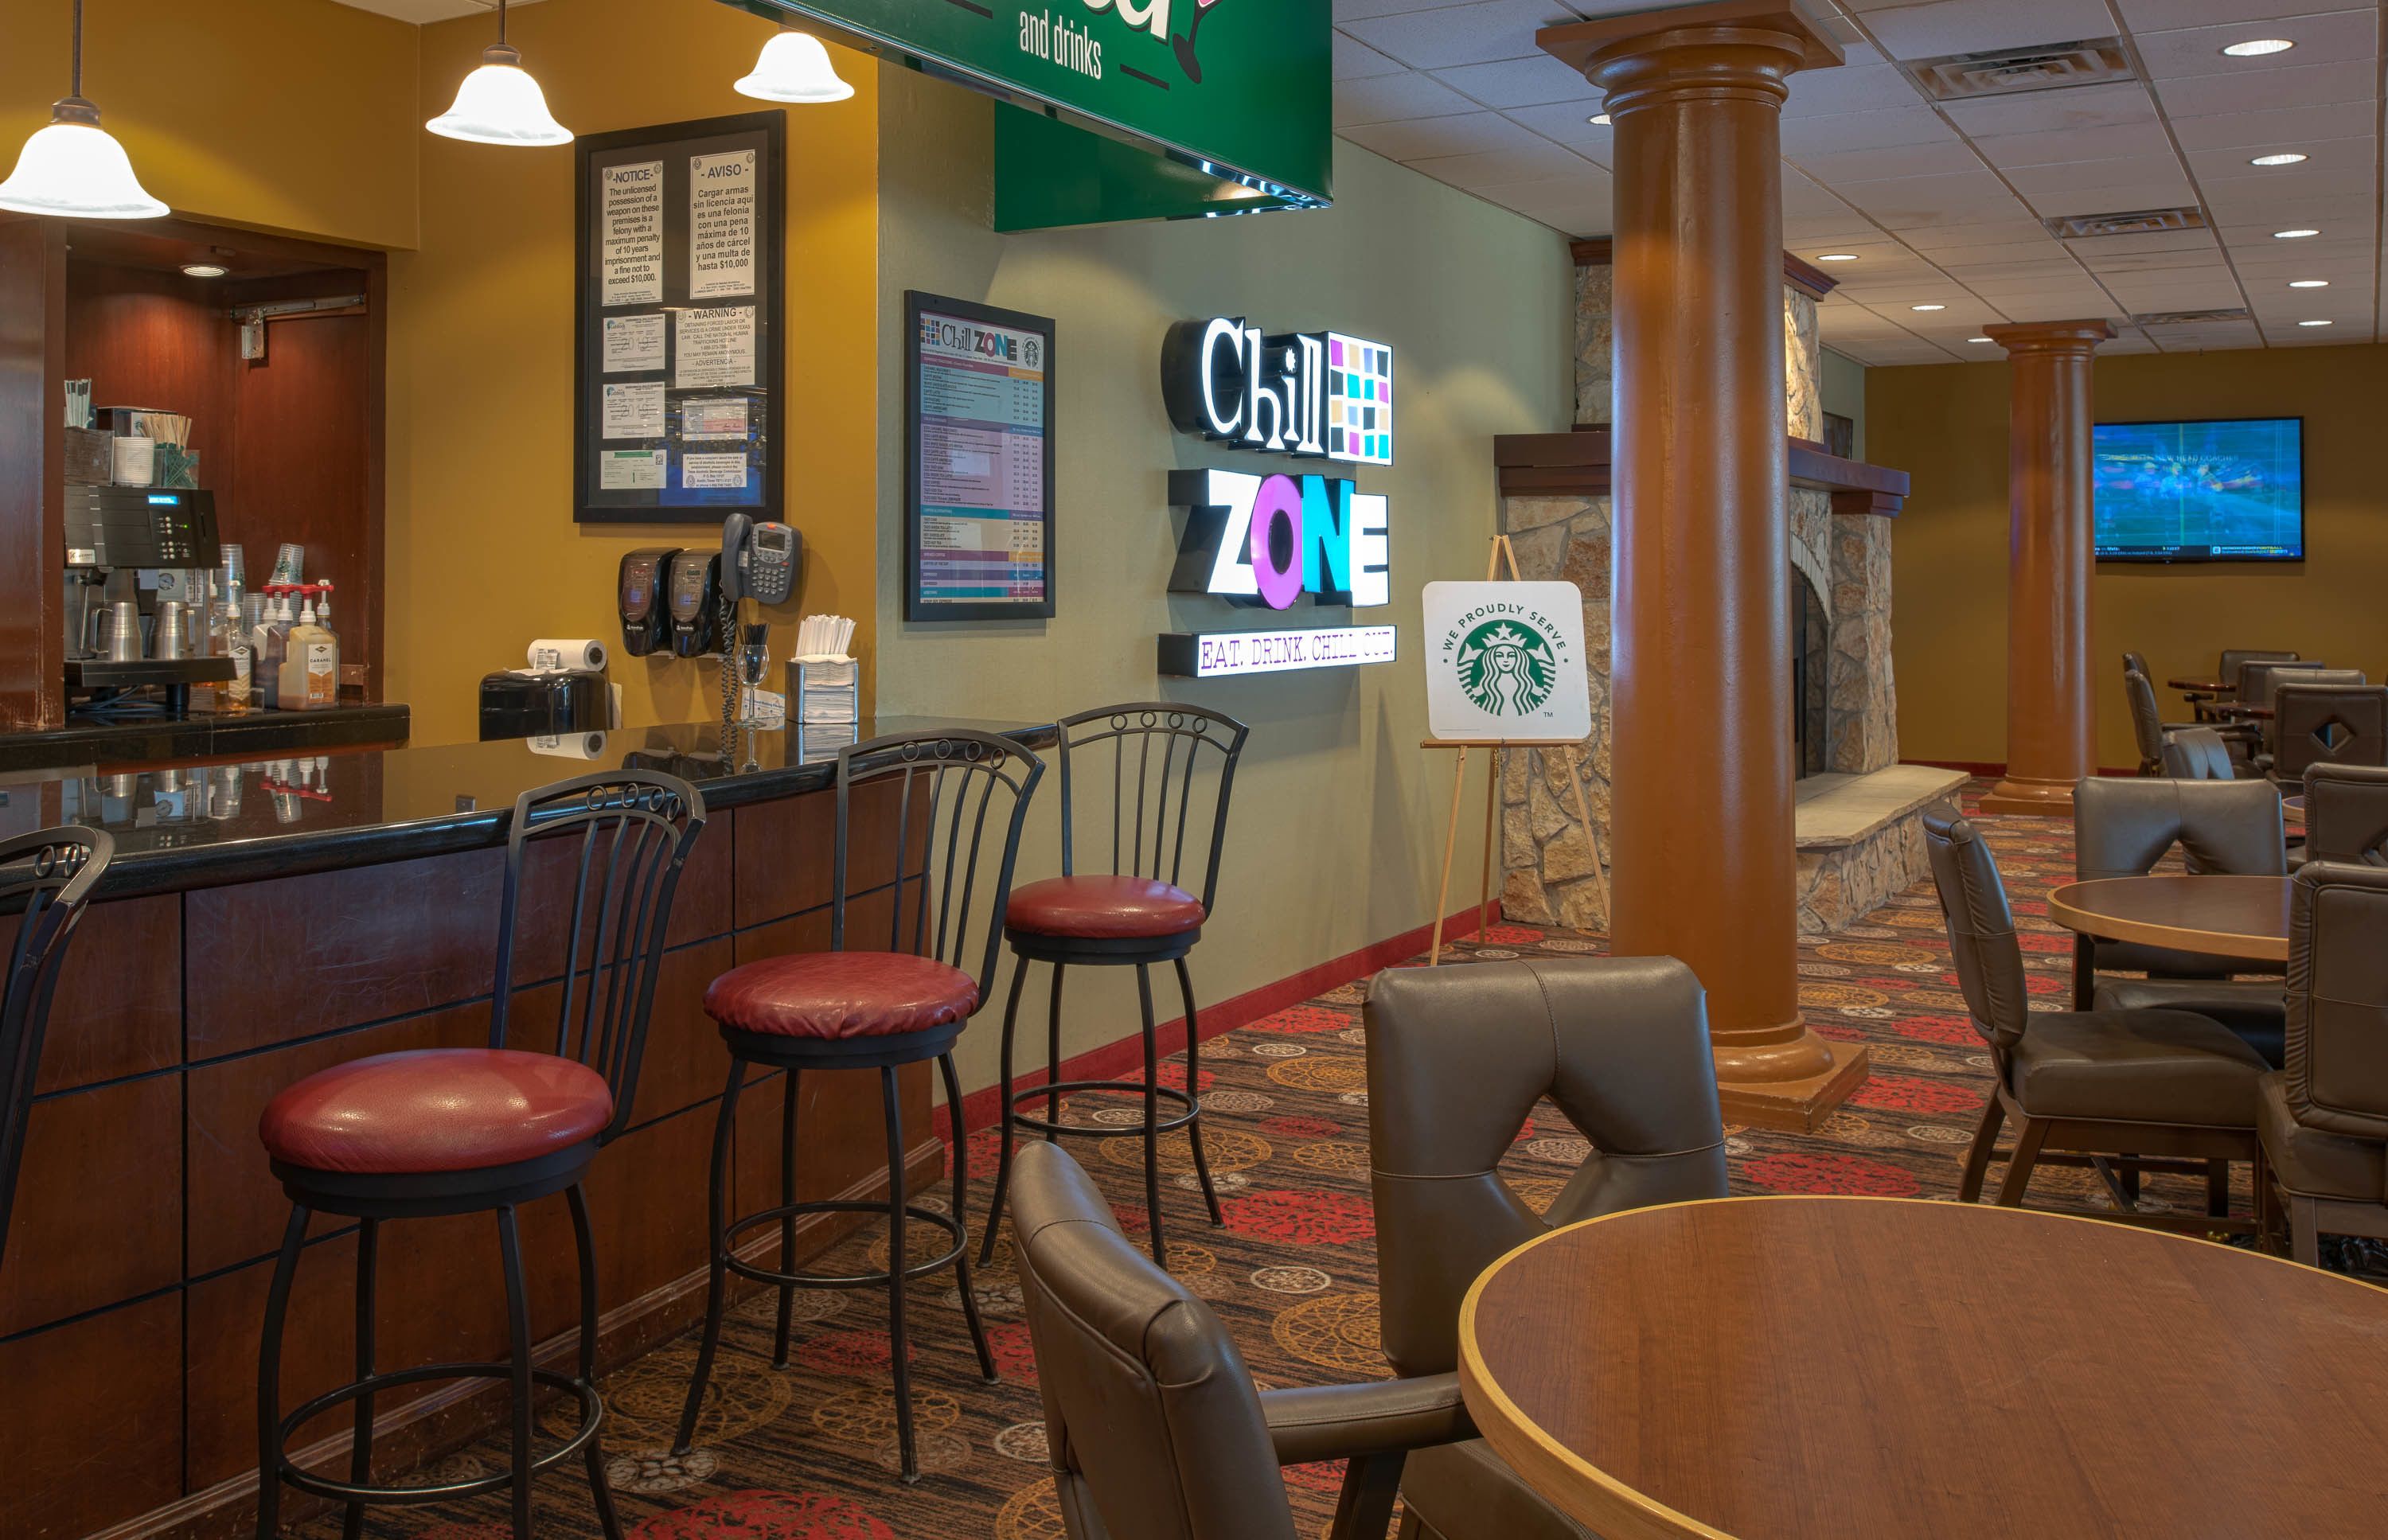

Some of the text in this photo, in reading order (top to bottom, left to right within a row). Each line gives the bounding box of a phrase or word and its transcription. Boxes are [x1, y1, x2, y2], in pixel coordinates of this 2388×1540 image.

[1020, 10, 1049, 60] and
[1054, 15, 1102, 80] drinks
[708, 164, 741, 178] AVISO
[610, 184, 657, 197] The unlicensed
[698, 186, 748, 198] Cargar armas
[608, 196, 644, 208] possession
[693, 201, 704, 209] sin
[706, 197, 735, 208] licencia
[607, 208, 630, 216] weapon
[612, 216, 641, 227] premises
[729, 217, 748, 228] pena
[613, 227, 632, 236] felony
[633, 224, 646, 233] with
[605, 233, 661, 246] maximum penalty
[615, 245, 649, 255] of 10 years
[696, 254, 700, 263] y
[718, 249, 739, 259] multa
[741, 248, 751, 256] de
[605, 252, 661, 267] imprisonment and
[720, 259, 748, 269] $10,000
[608, 273, 657, 285] exceed $10,000.
[693, 307, 736, 320] WARNING
[942, 324, 971, 351] Chill
[974, 330, 1017, 361] ZONE
[696, 358, 733, 367] ADVERTENCA
[1202, 318, 1325, 454] Chill
[1208, 469, 1389, 610] ZONE
[1443, 603, 1567, 651] WE PROUDLY SERVE
[1200, 640, 1243, 669] EAT.
[1251, 637, 1306, 665] DRINK.
[1312, 634, 1357, 661] CHILL
